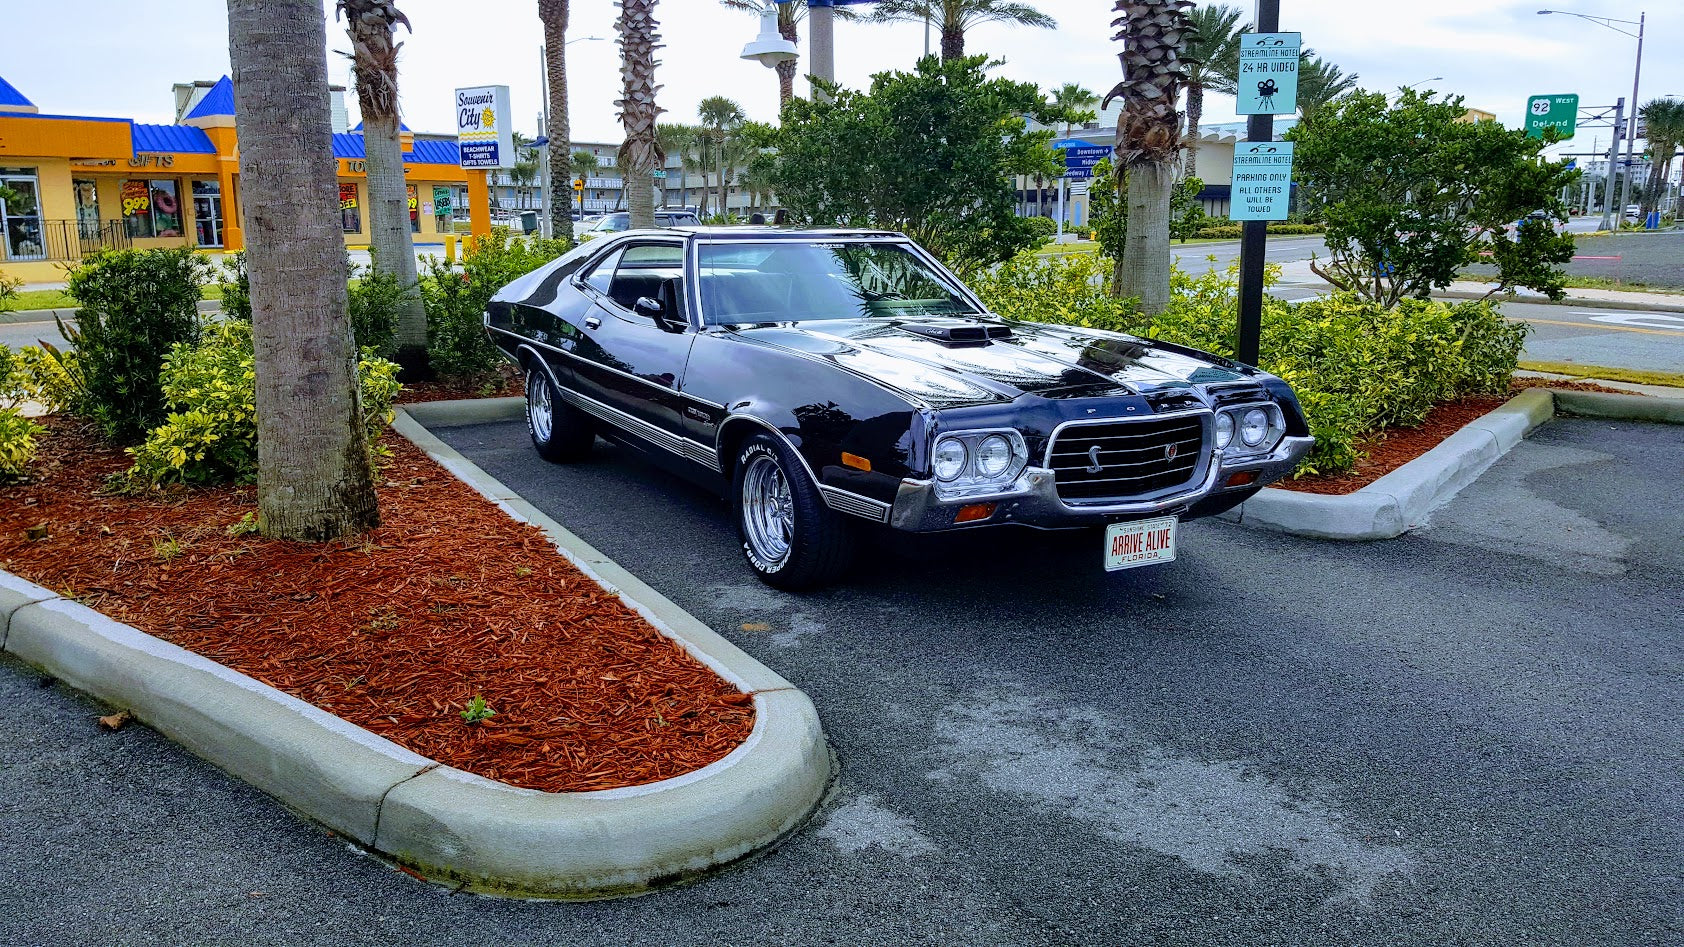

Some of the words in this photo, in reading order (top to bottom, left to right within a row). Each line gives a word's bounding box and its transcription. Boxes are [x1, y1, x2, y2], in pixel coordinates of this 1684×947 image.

[1241, 49, 1279, 58] STREAMLINE
[1281, 48, 1299, 57] HOTEL
[1242, 63, 1254, 73] 24
[1257, 62, 1268, 73] HR
[1271, 61, 1295, 72] VIDEO
[458, 91, 494, 107] Souvenir
[1533, 102, 1549, 112] 92
[459, 107, 481, 130] City
[463, 146, 495, 154] BEACHWEAR
[128, 154, 174, 168] GIFTS
[477, 158, 498, 166] TOWELS
[1081, 158, 1100, 166] Midtow
[1234, 156, 1272, 164] STREAMLINE
[1273, 156, 1292, 164] HOTEL
[1065, 169, 1085, 177] eedway
[1236, 173, 1267, 182] PARKING
[1269, 173, 1287, 182] ONLY
[1254, 186, 1282, 194] OTHERS
[1246, 196, 1262, 204] WILL
[1247, 205, 1271, 213] TOWED
[741, 444, 766, 464] RADIAL
[1111, 532, 1144, 556] ARRIVE
[1145, 528, 1171, 551] ALIVE
[743, 541, 766, 571] COBRA
[1121, 551, 1158, 562] FLORIDA
